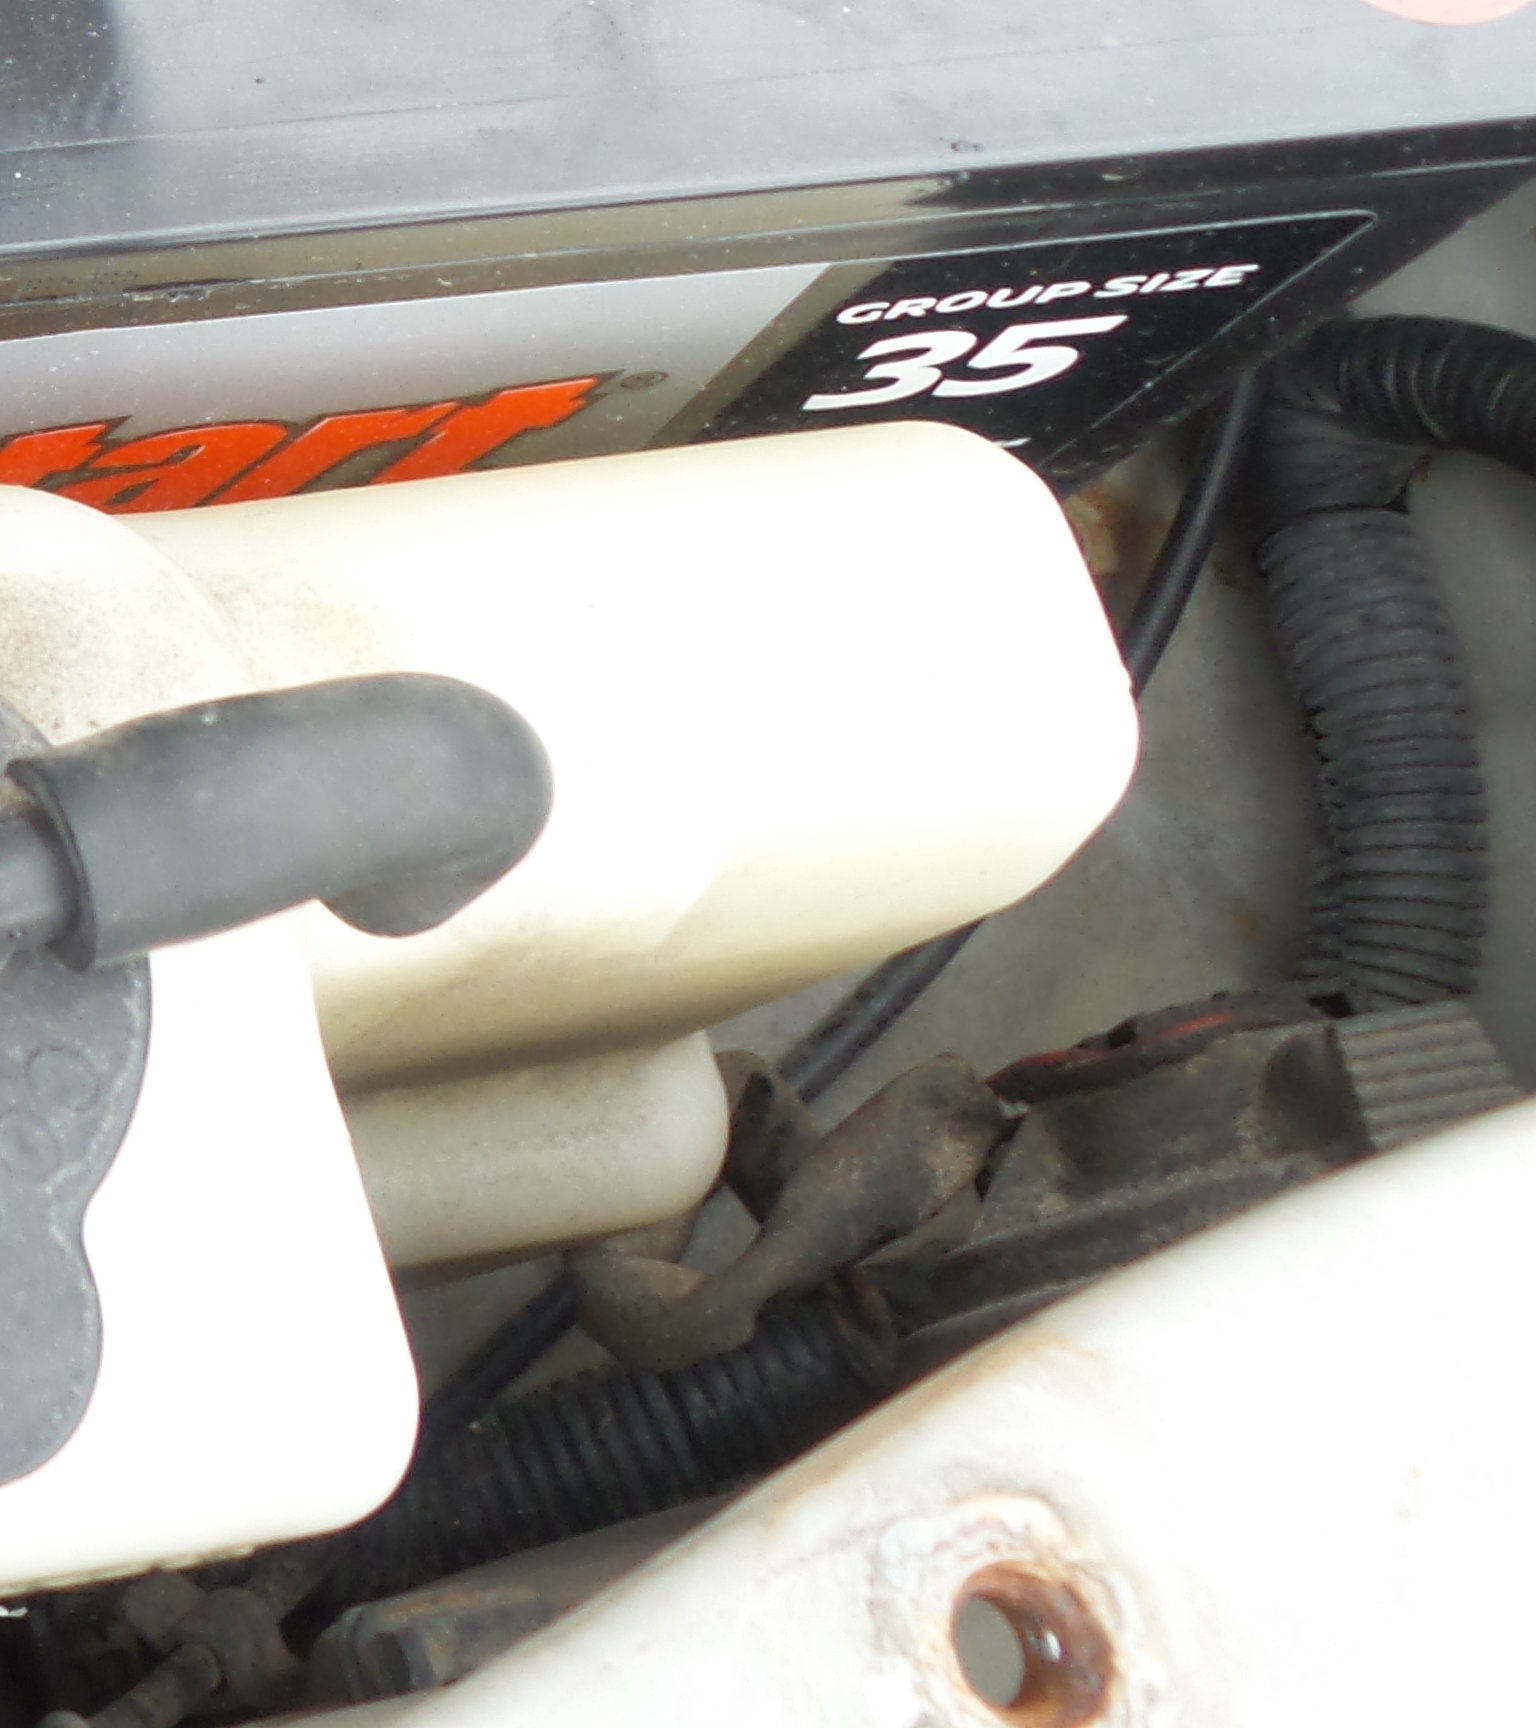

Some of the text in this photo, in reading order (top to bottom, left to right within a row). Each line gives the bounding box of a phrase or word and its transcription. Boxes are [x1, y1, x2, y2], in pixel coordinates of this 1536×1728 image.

[836, 264, 1263, 325] GROUP SIZE
[801, 314, 1129, 412] 35
